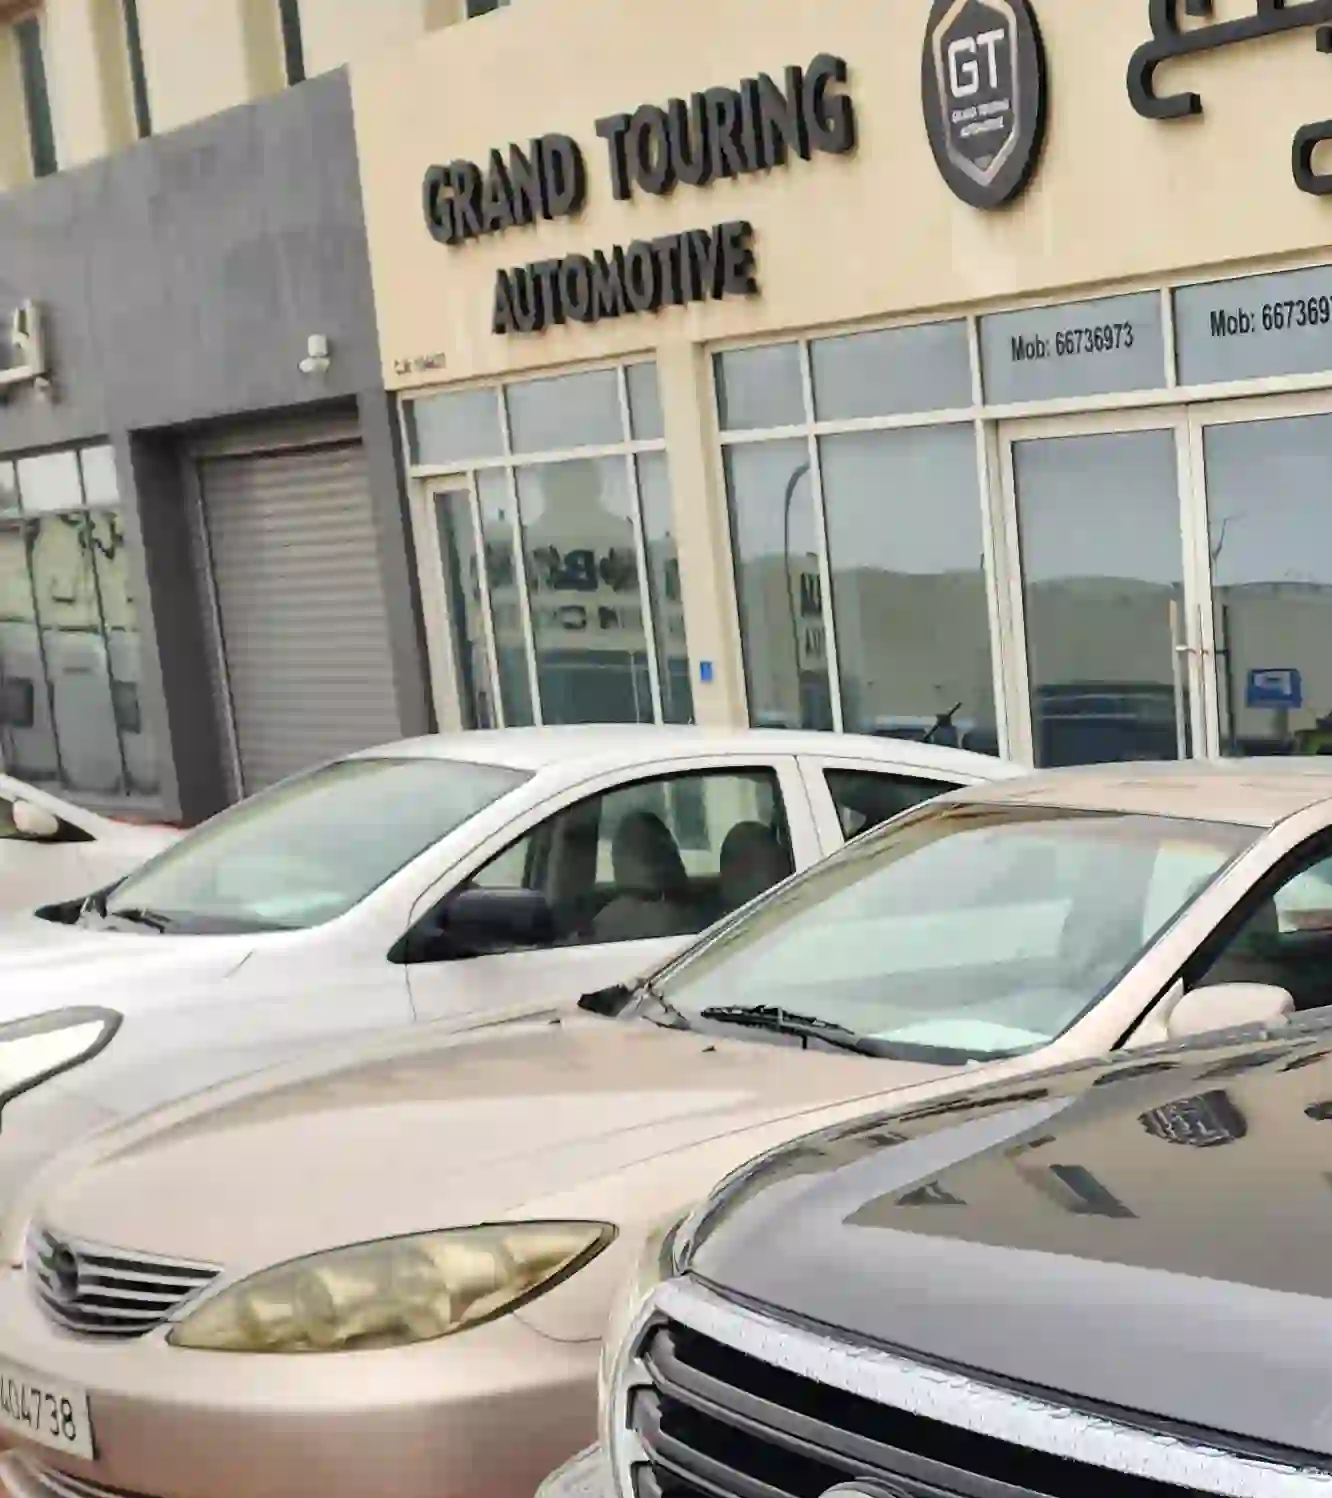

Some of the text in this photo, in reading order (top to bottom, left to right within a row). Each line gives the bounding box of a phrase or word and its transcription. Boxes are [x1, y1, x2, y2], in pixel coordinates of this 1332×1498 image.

[948, 28, 1004, 98] GT
[422, 52, 856, 245] GRAND TOURING
[492, 220, 760, 335] AUTOMOTIVE
[1011, 320, 1134, 361] Mob: 66736973
[1210, 310, 1255, 337] Mob:
